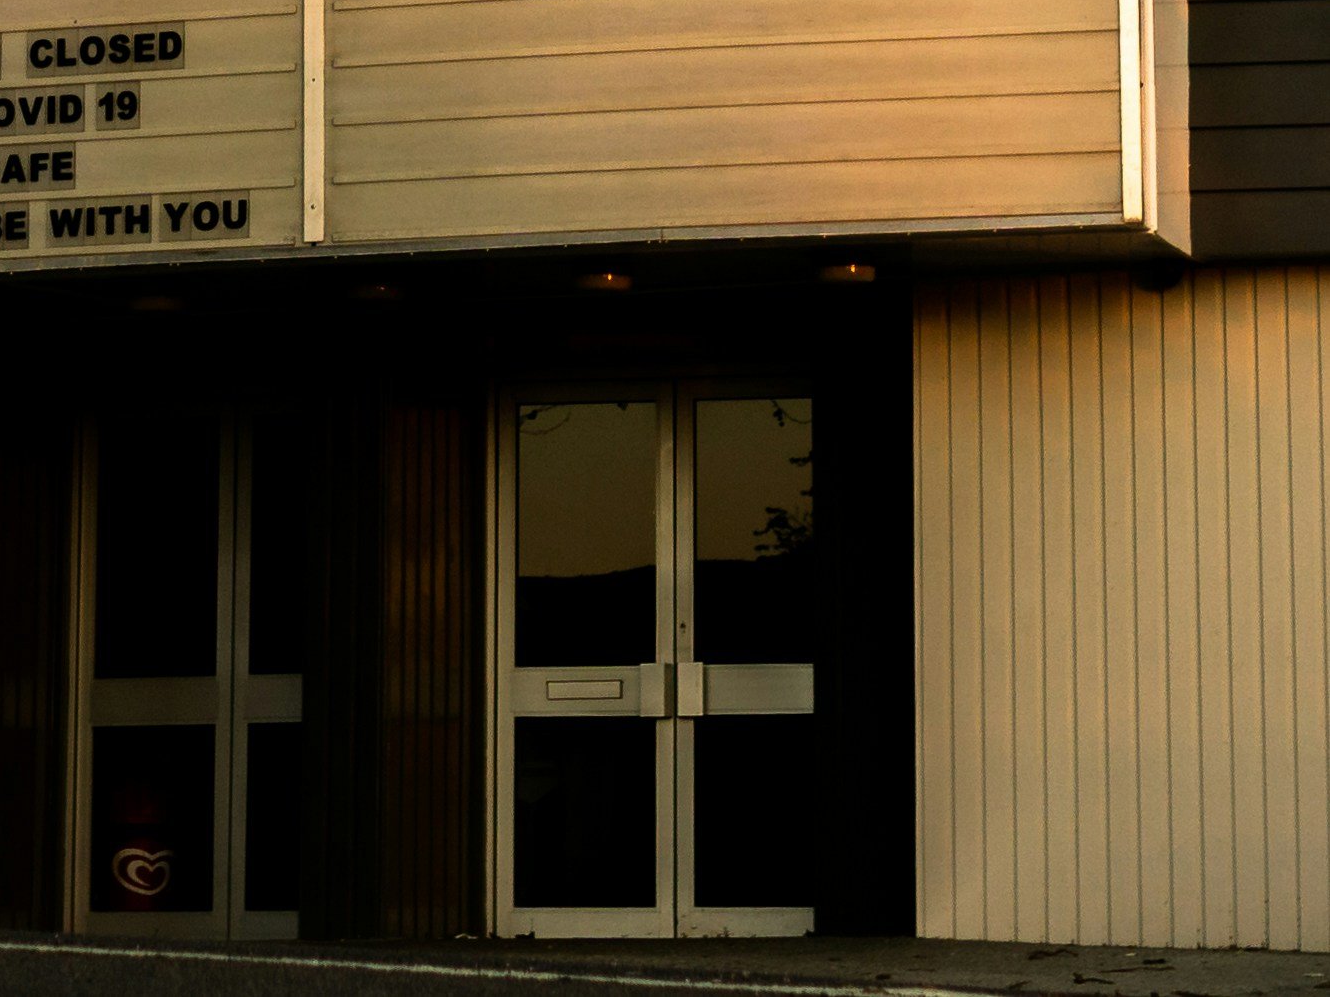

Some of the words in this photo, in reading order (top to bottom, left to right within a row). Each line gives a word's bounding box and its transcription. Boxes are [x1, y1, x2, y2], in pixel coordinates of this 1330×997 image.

[28, 30, 183, 69] CLOSED
[98, 90, 139, 123] 19
[49, 203, 150, 239] WITH
[162, 199, 249, 233] YOU
